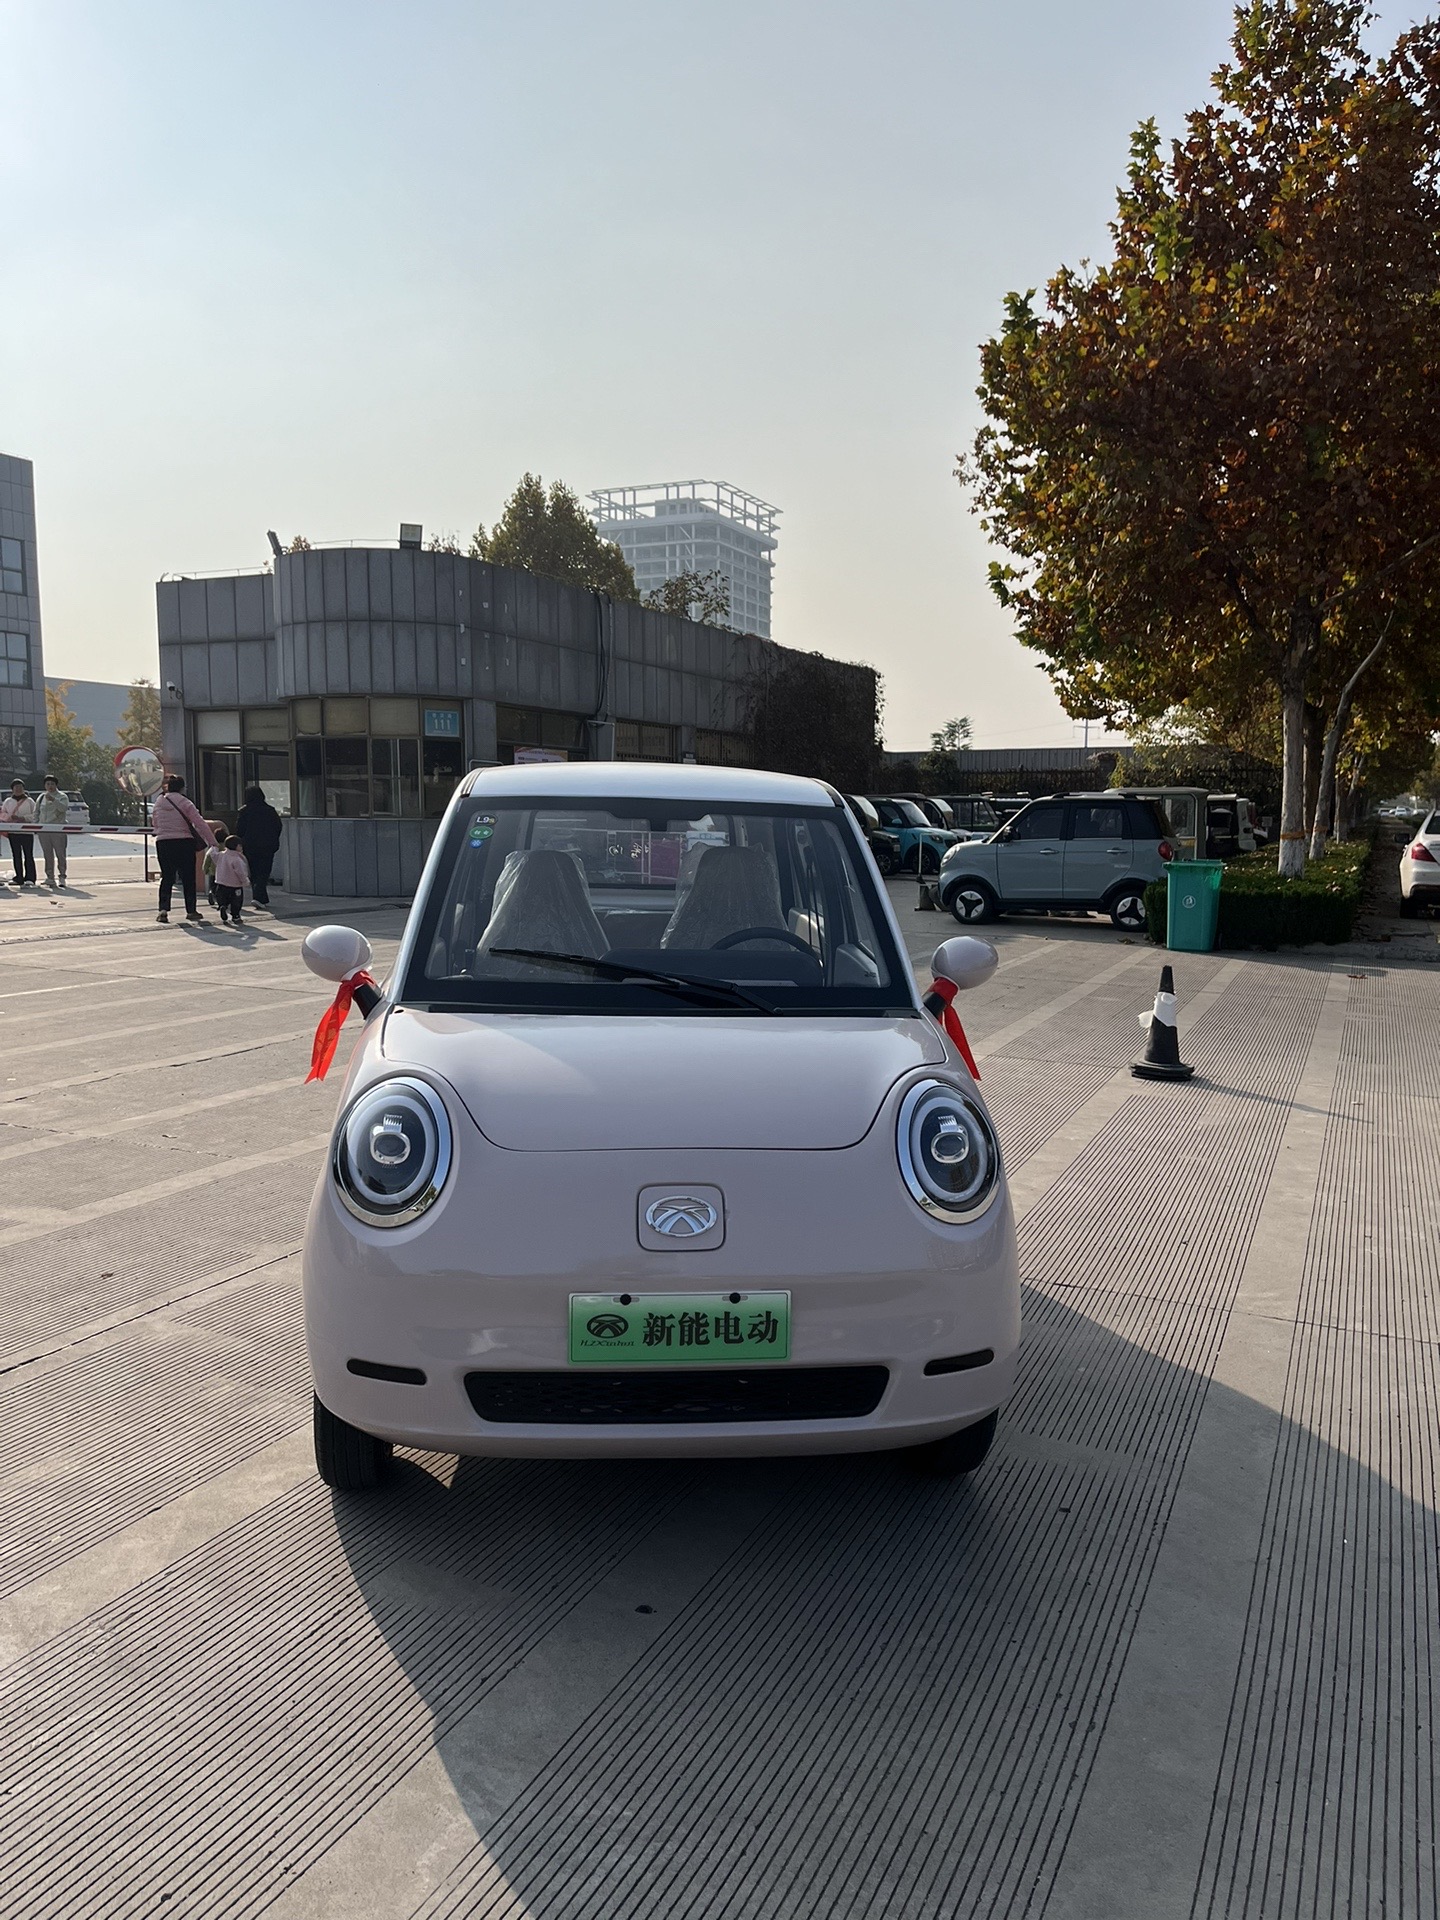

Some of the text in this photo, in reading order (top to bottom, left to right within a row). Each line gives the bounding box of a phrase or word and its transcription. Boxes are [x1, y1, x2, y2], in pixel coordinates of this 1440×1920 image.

[434, 718, 451, 730] 111
[642, 1310, 780, 1347] 新能电动
